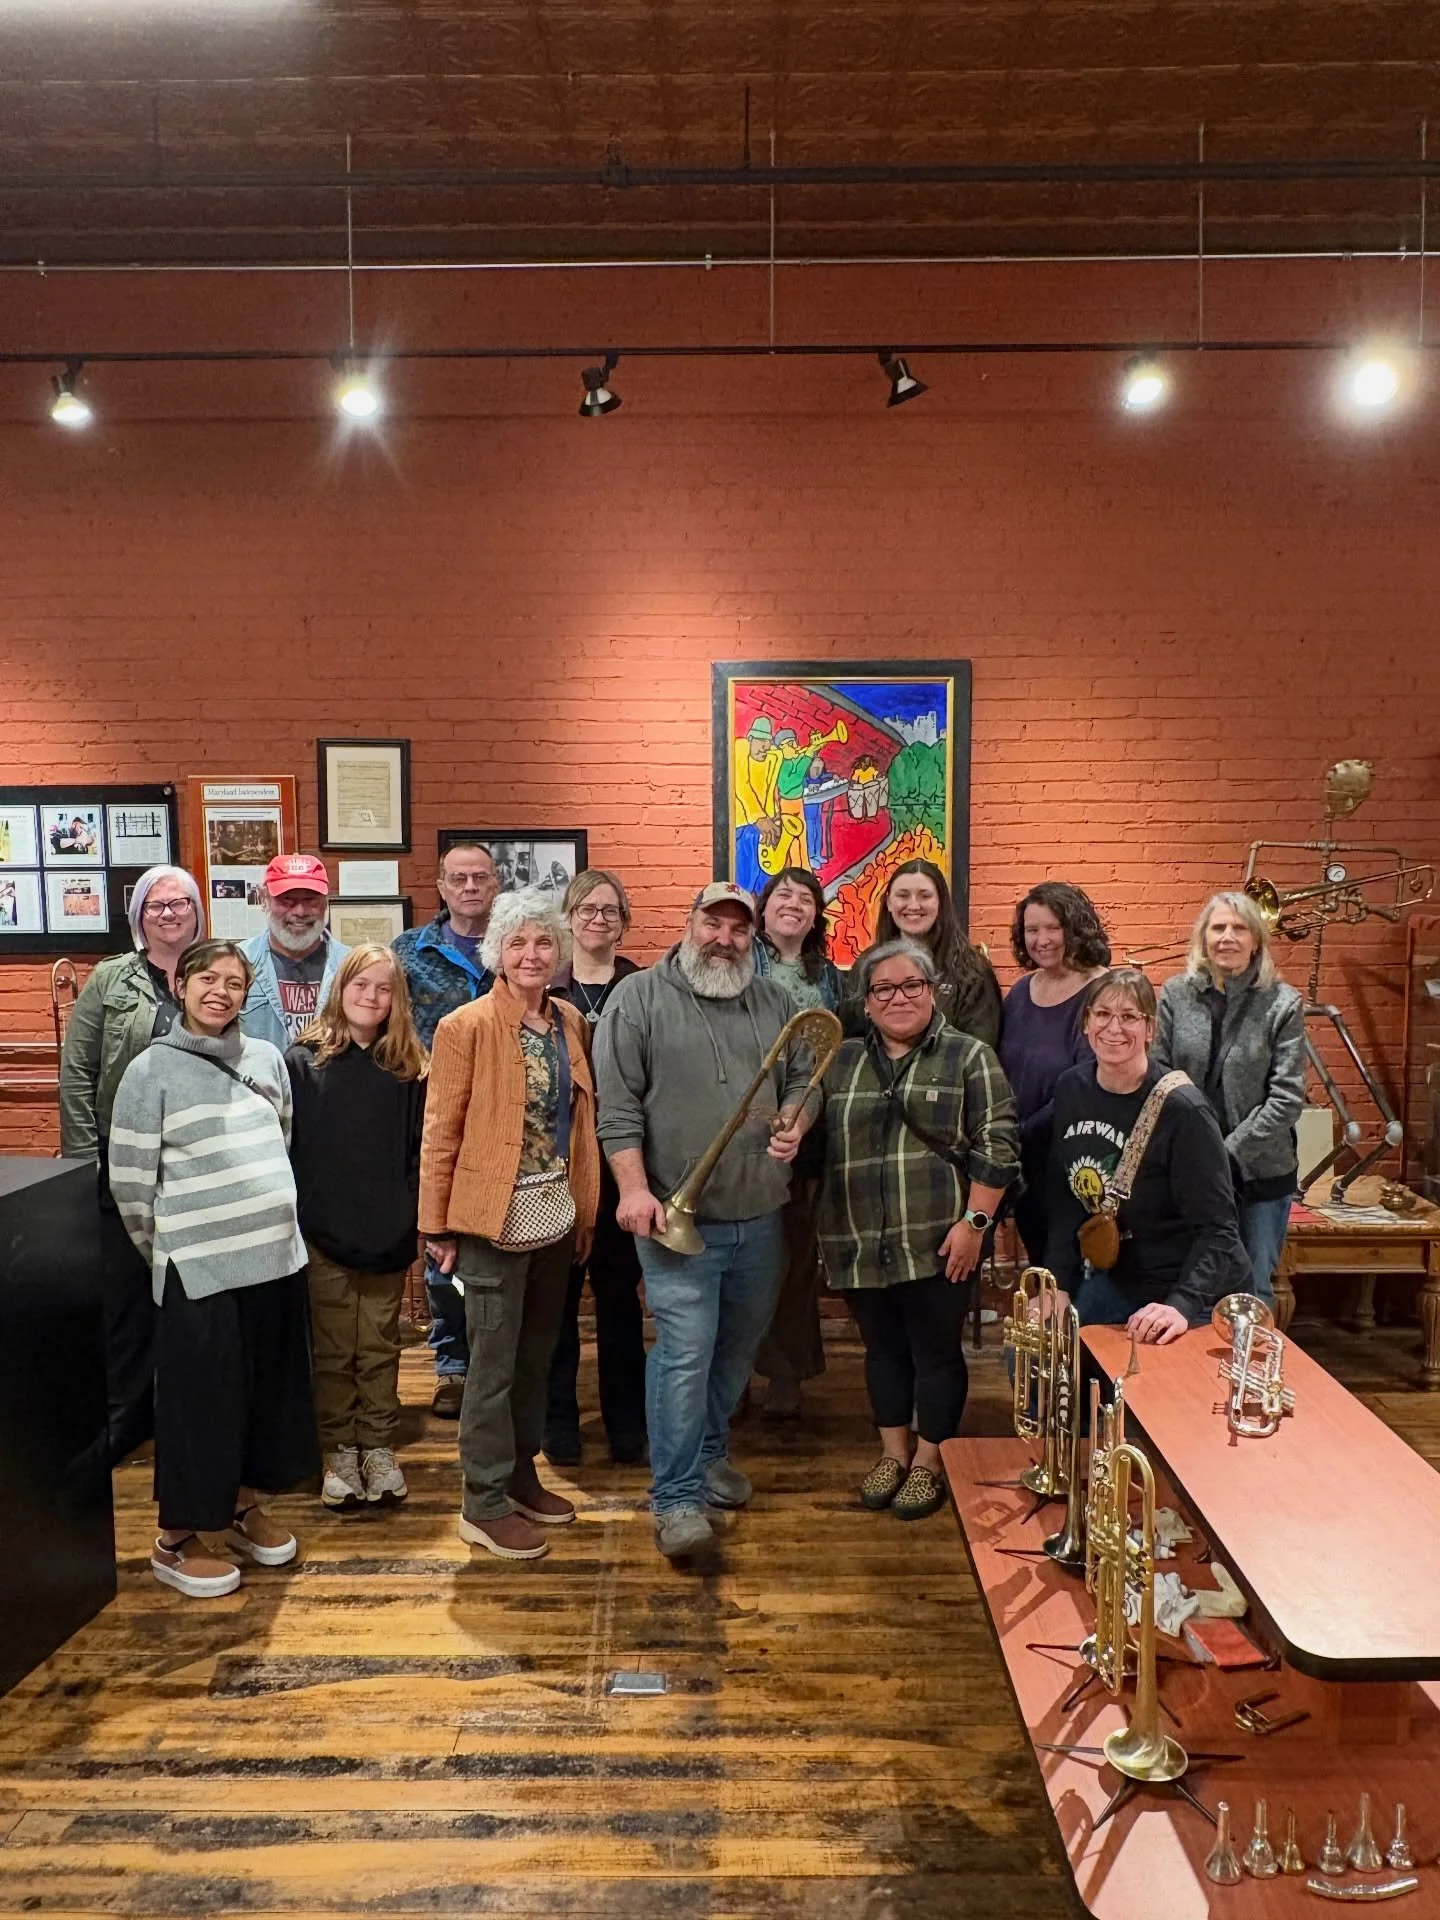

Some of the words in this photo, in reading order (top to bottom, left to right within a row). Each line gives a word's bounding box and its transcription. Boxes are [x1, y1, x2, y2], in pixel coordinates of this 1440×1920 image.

[207, 787, 236, 797] Maryland
[238, 787, 275, 797] Independent
[1063, 1120, 1127, 1149] AIRWAL
